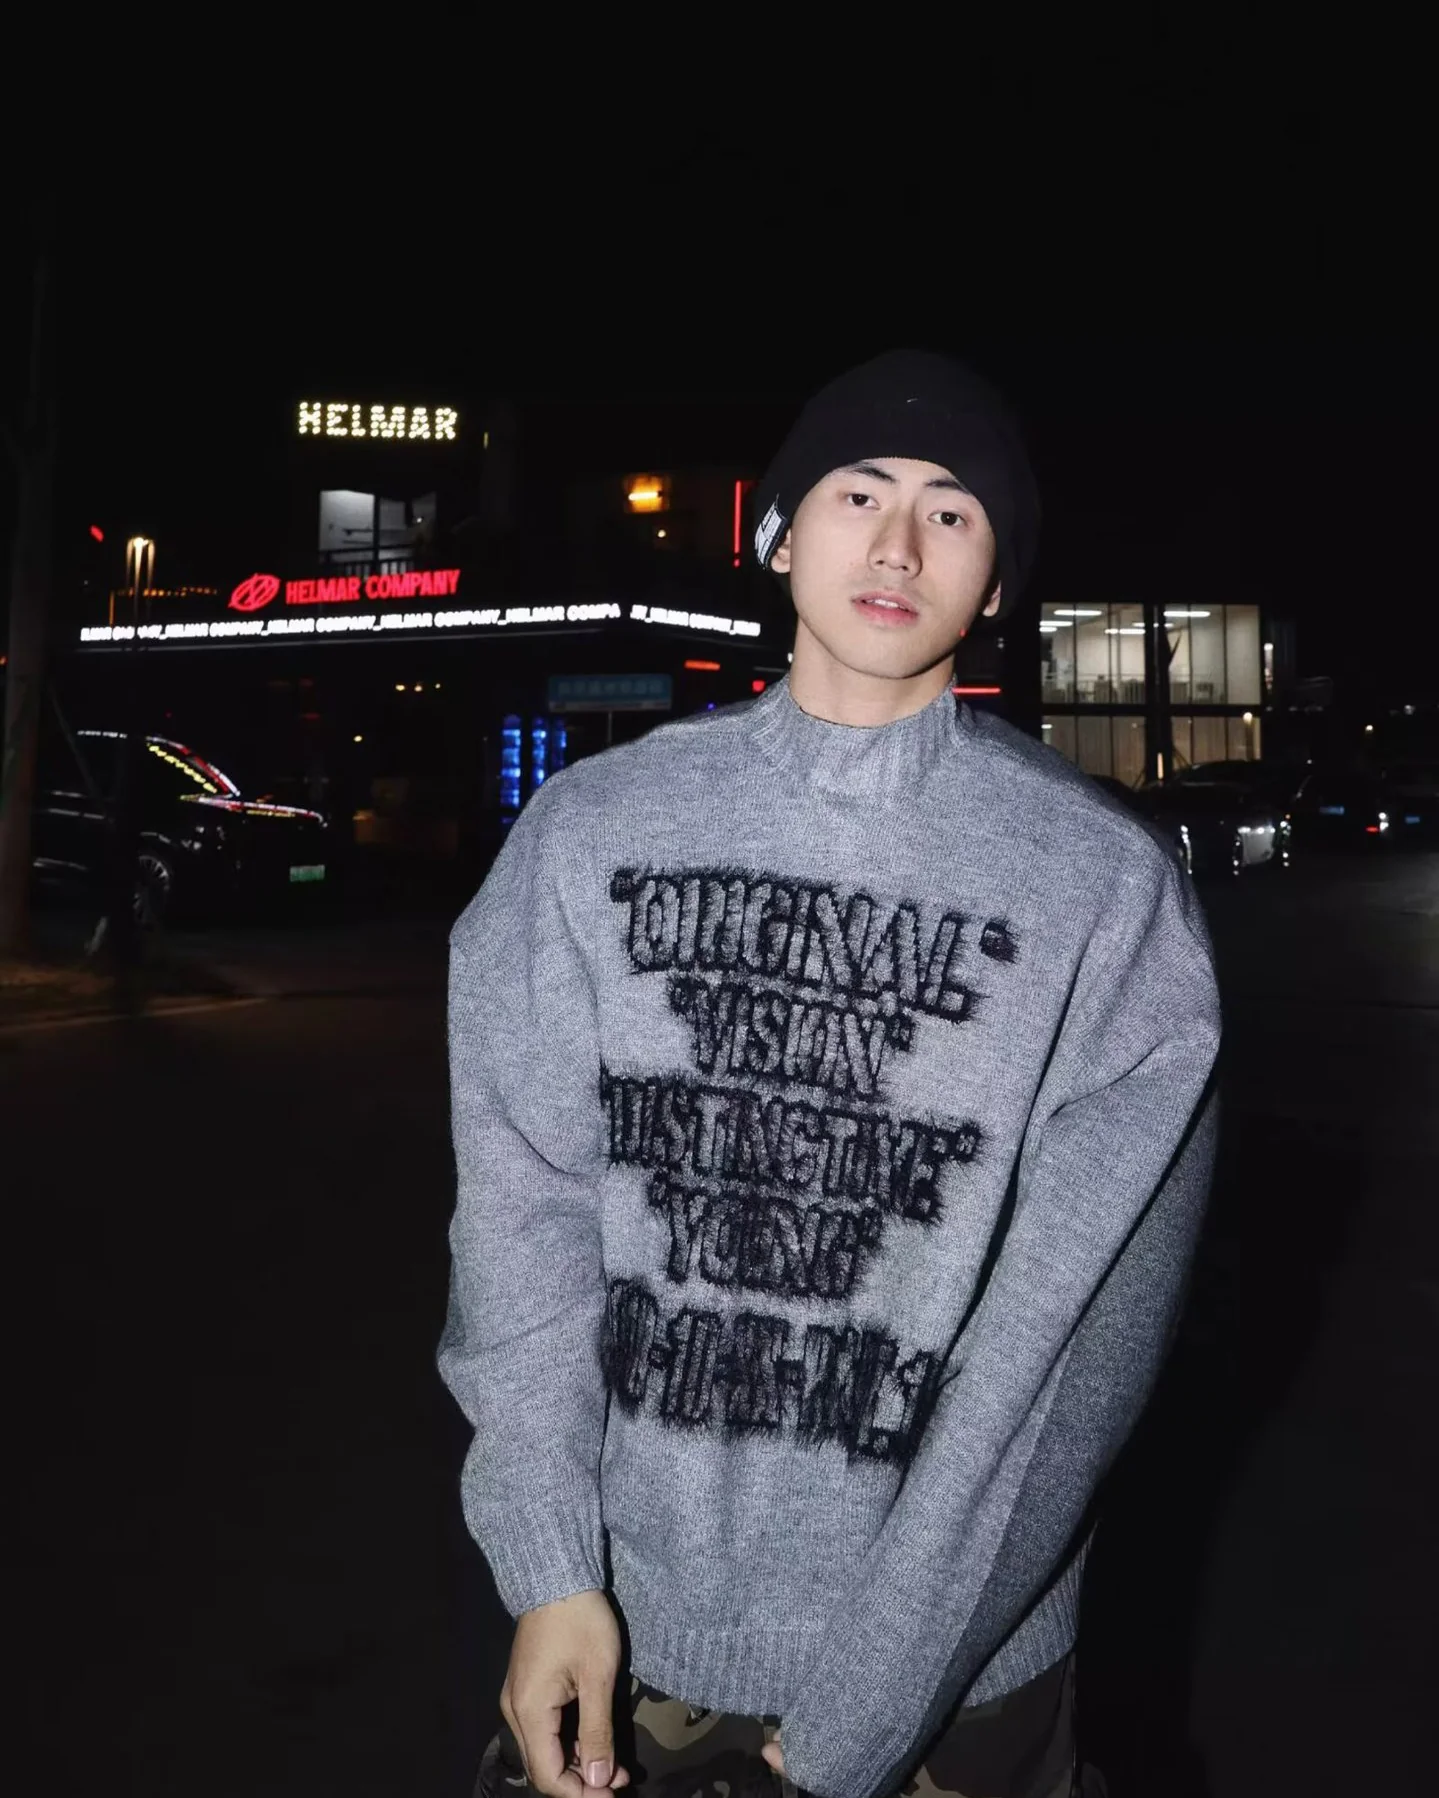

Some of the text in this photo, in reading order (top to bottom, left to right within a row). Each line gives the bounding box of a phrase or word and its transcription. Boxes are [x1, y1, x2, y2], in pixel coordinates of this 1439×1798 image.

[299, 402, 457, 440] HELMAR
[286, 569, 460, 604] HELMAR COMPANY
